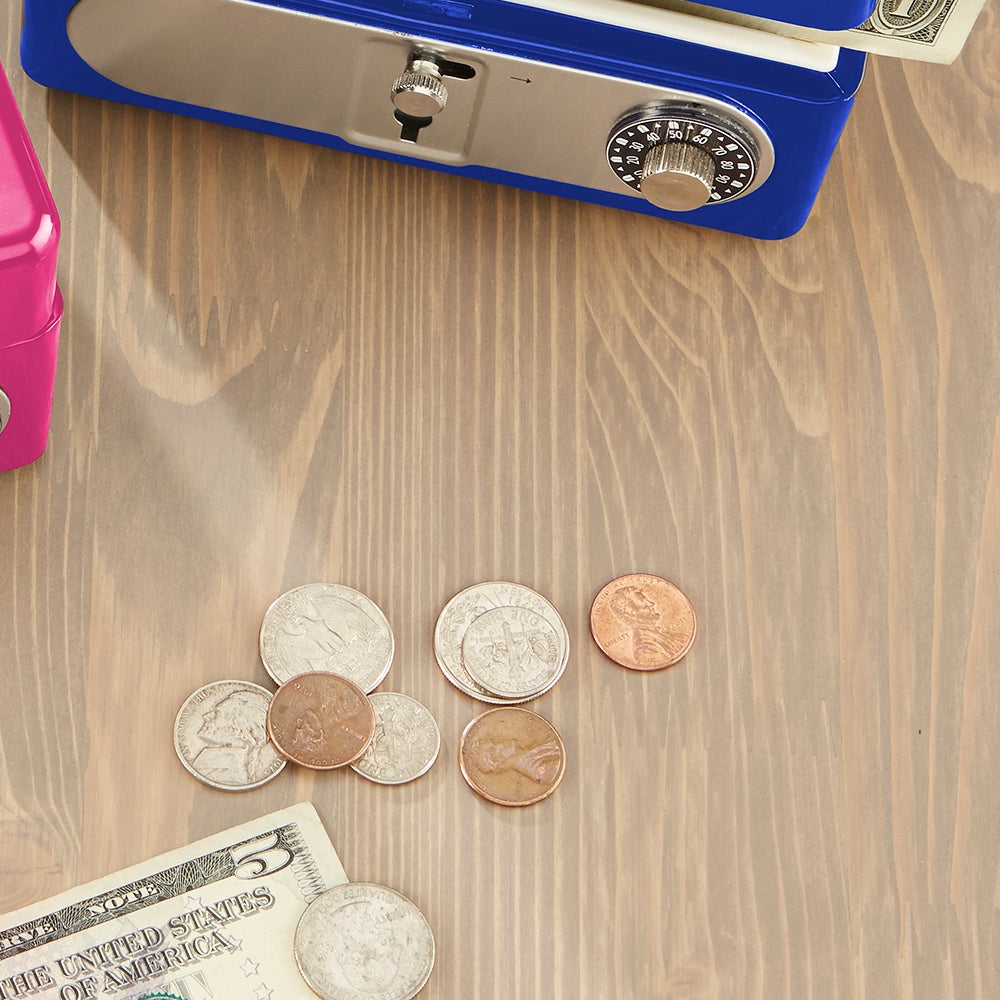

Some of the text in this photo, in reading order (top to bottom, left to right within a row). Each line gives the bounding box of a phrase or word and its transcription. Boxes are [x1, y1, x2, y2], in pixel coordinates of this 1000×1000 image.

[647, 133, 660, 143] 40
[669, 130, 683, 139] 50
[692, 135, 708, 145] 60
[629, 142, 644, 152] 30
[712, 146, 727, 156] 70
[626, 155, 640, 165] 20
[721, 160, 734, 170] 80
[235, 832, 295, 880] 5
[87, 882, 160, 917] NOTE
[55, 926, 166, 979] UNITED
[168, 885, 276, 938] STATES
[60, 978, 99, 1000] OF
[101, 930, 234, 992] AMERICA
